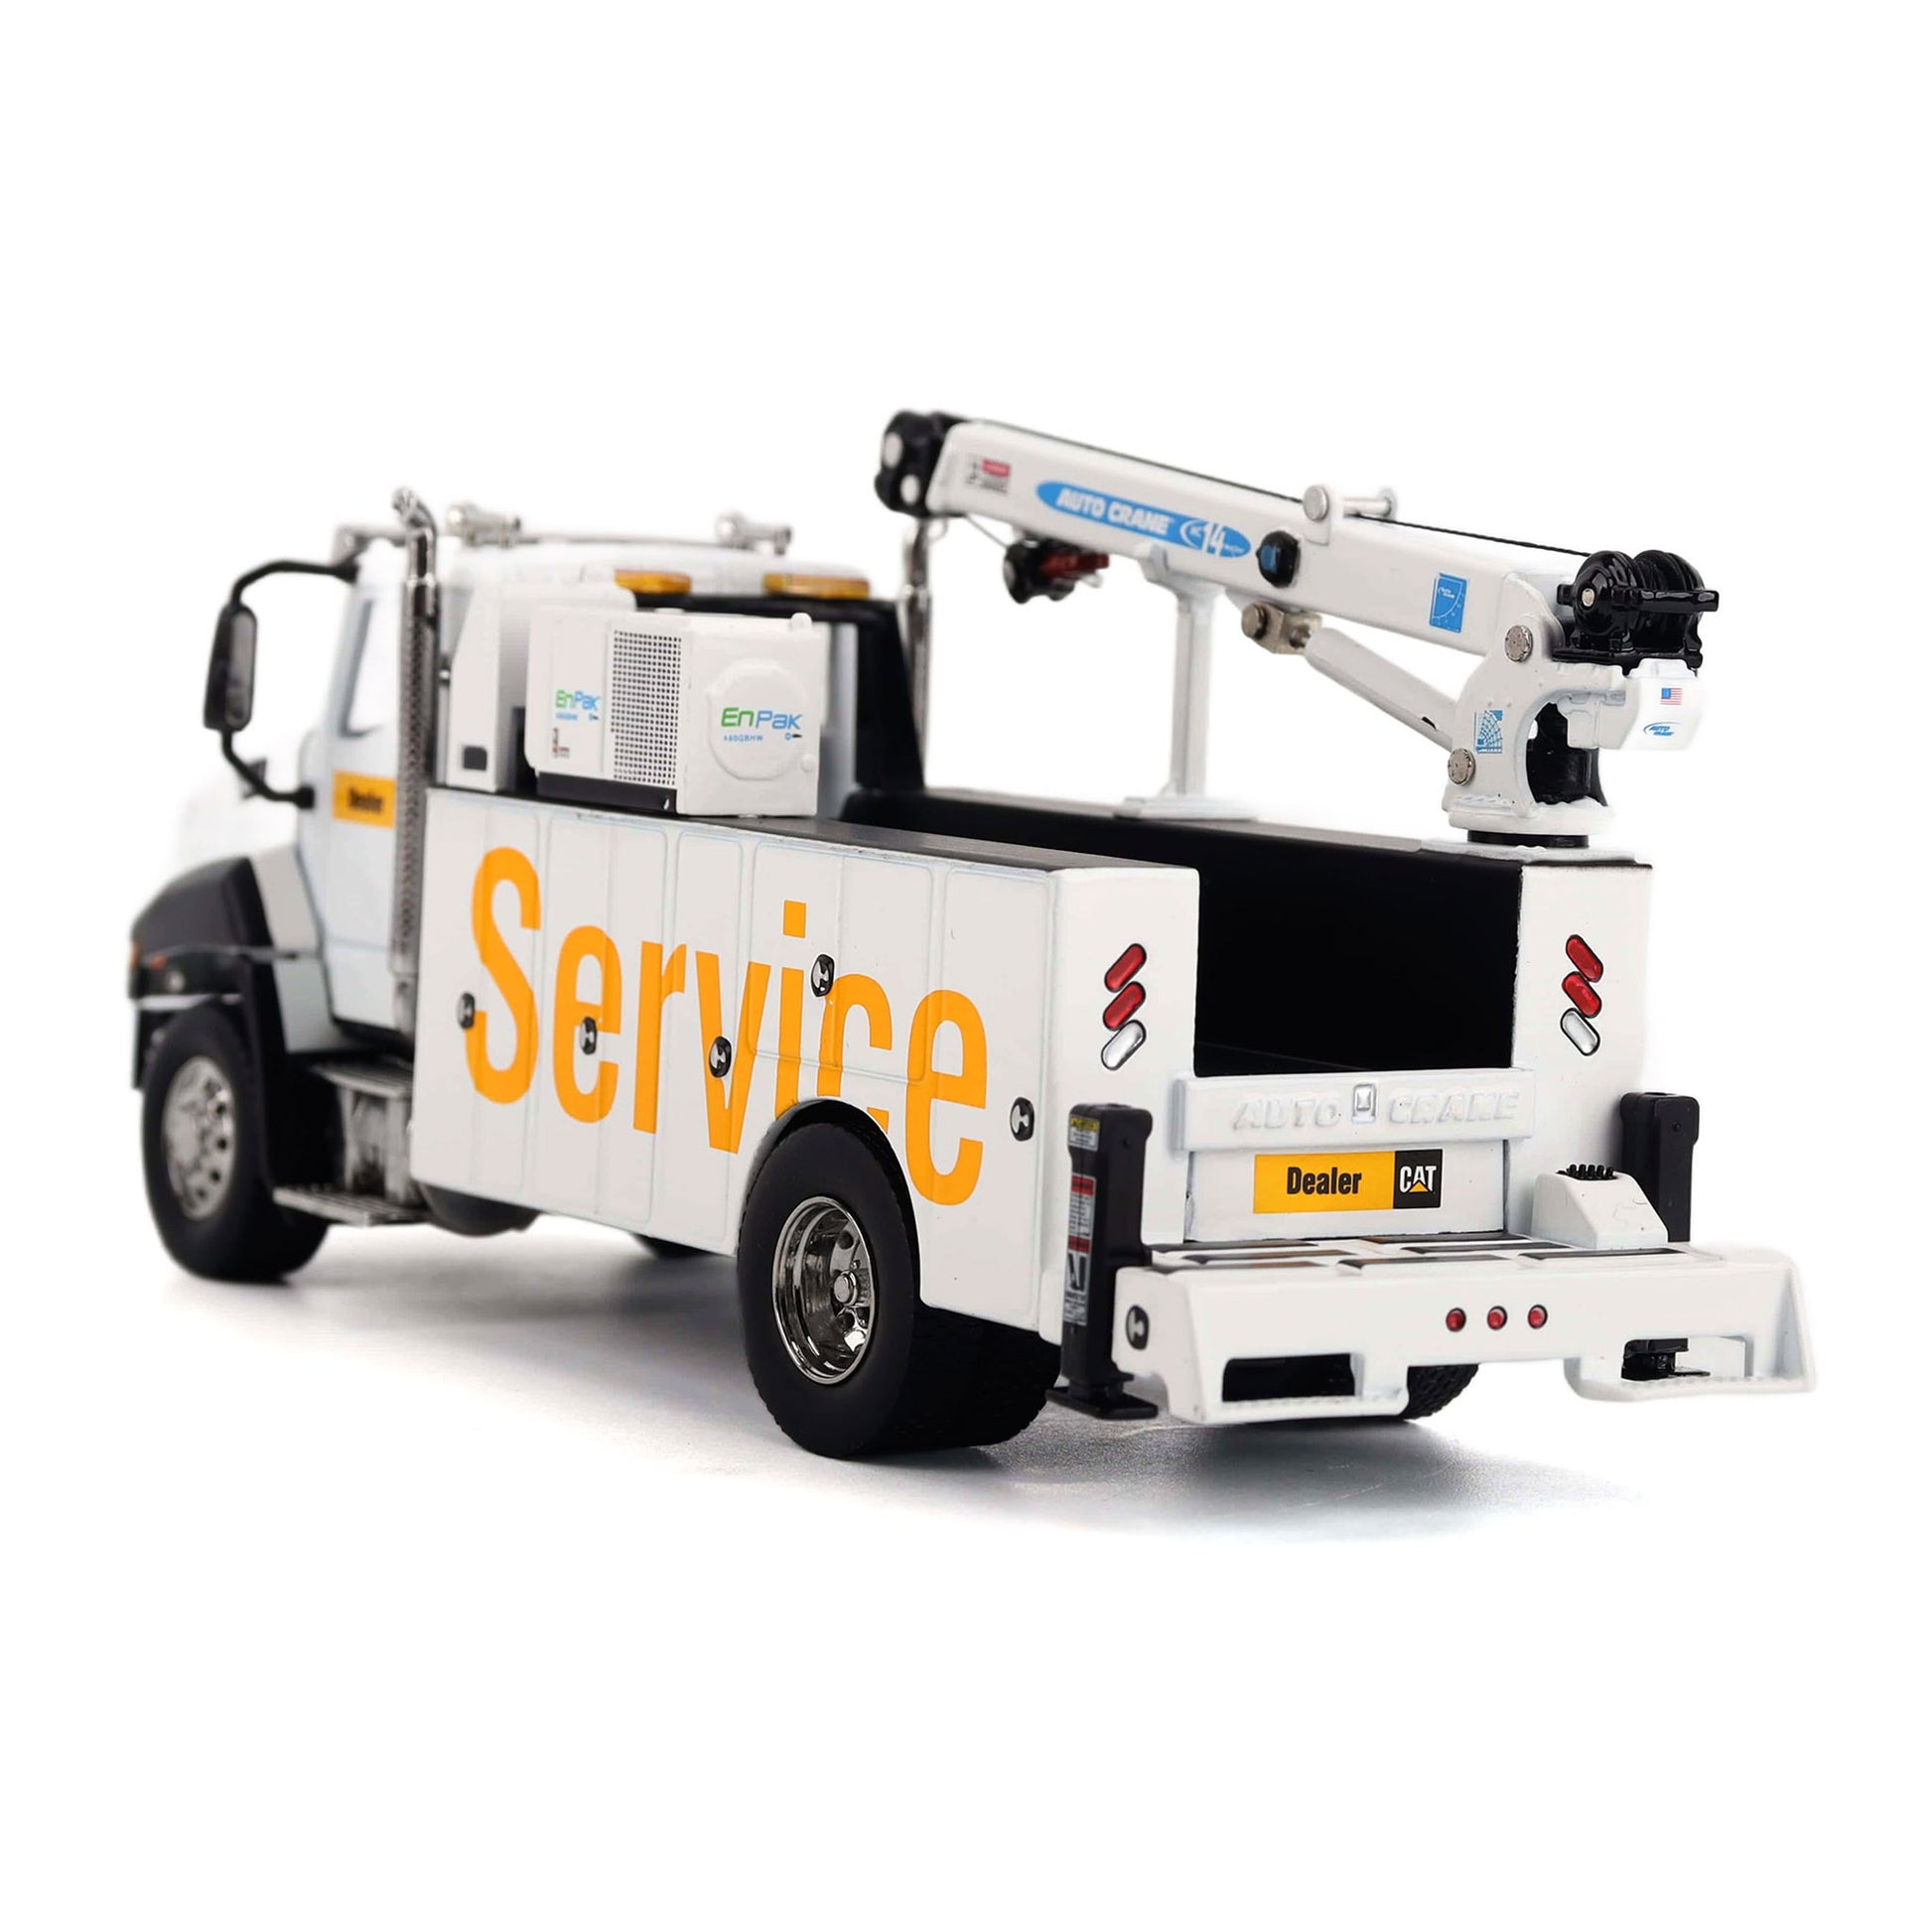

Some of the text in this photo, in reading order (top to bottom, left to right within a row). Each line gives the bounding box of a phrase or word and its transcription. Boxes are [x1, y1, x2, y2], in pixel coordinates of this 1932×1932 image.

[1056, 486, 1171, 535] AUTO CRANE
[1200, 520, 1227, 557] 14
[554, 688, 602, 711] EnPak
[721, 707, 802, 731] EnPak
[464, 846, 987, 1205] Service
[1232, 1090, 1521, 1131] AUTO CRANE
[1287, 1165, 1437, 1195] Dealer CAT
